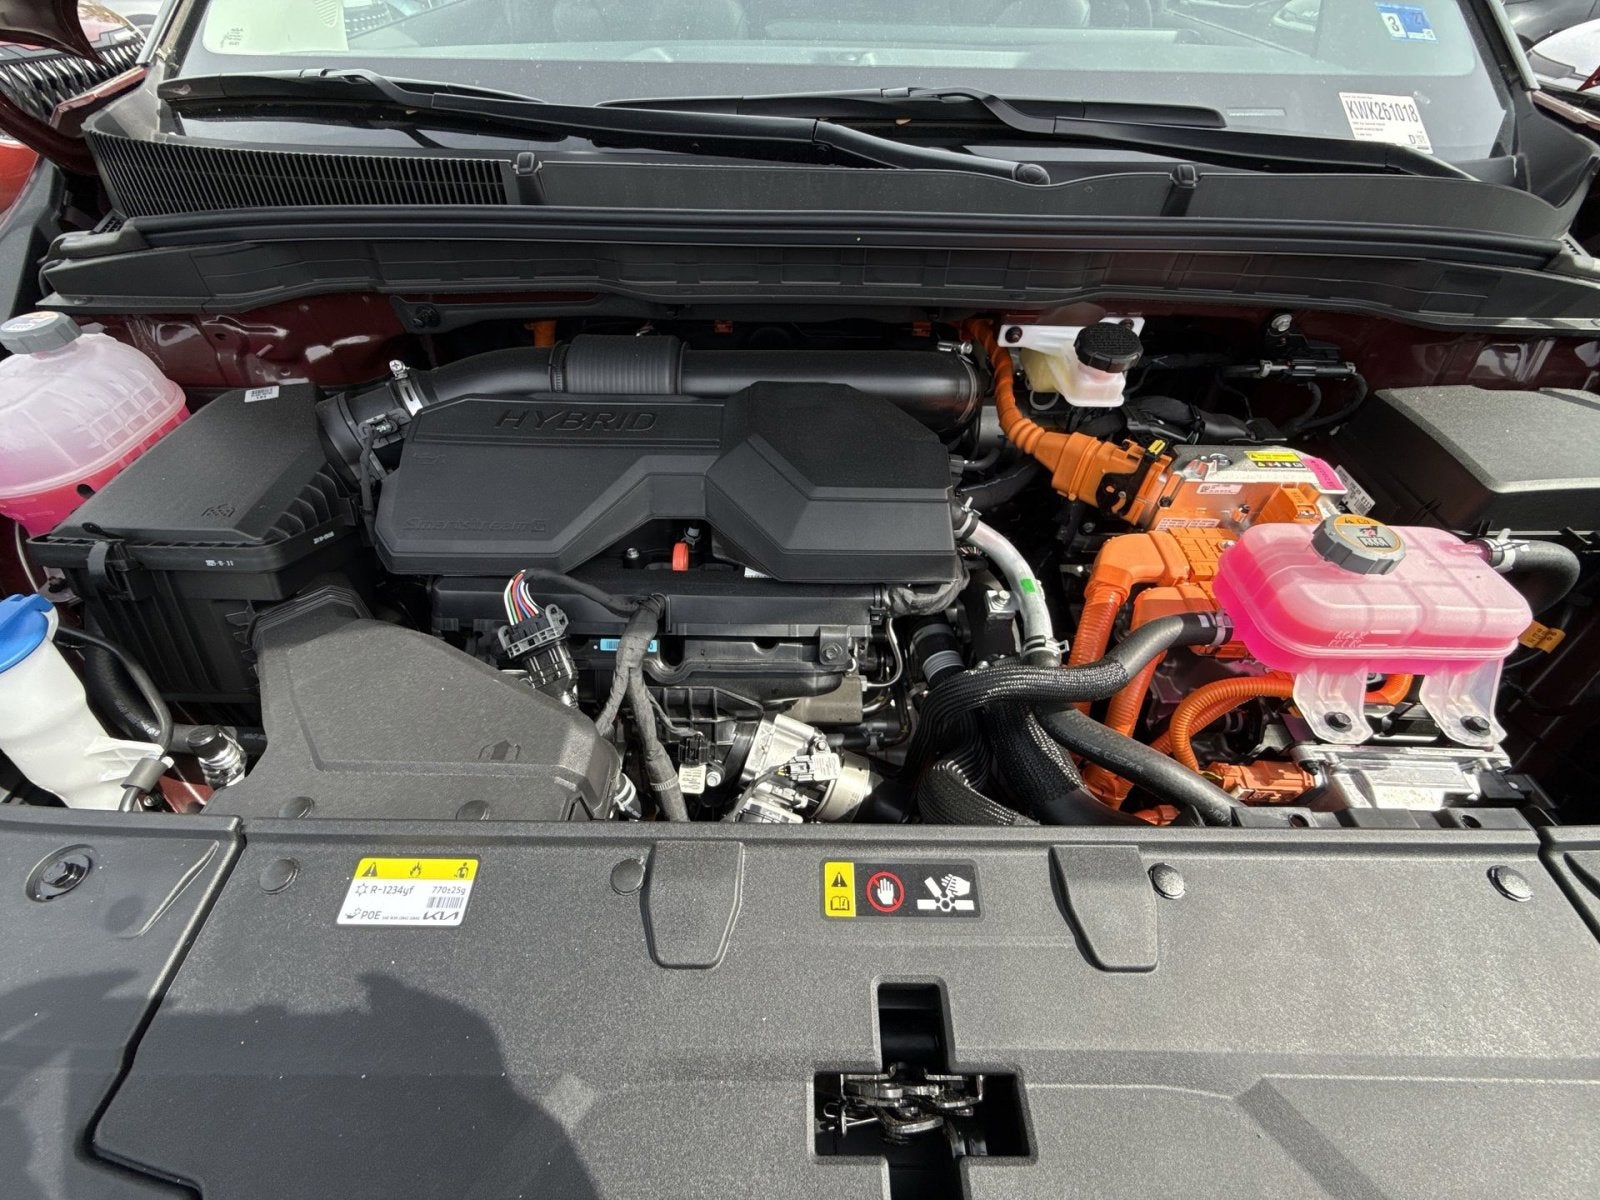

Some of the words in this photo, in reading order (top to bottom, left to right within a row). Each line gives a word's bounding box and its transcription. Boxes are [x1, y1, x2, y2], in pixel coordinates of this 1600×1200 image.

[1387, 15, 1401, 32] 3
[1345, 99, 1419, 123] KWK261018
[494, 409, 658, 432] HYBRID
[369, 884, 415, 897] R-1234yf
[431, 885, 467, 896] 770±25g
[360, 910, 382, 921] POE
[422, 911, 460, 921] KIA
